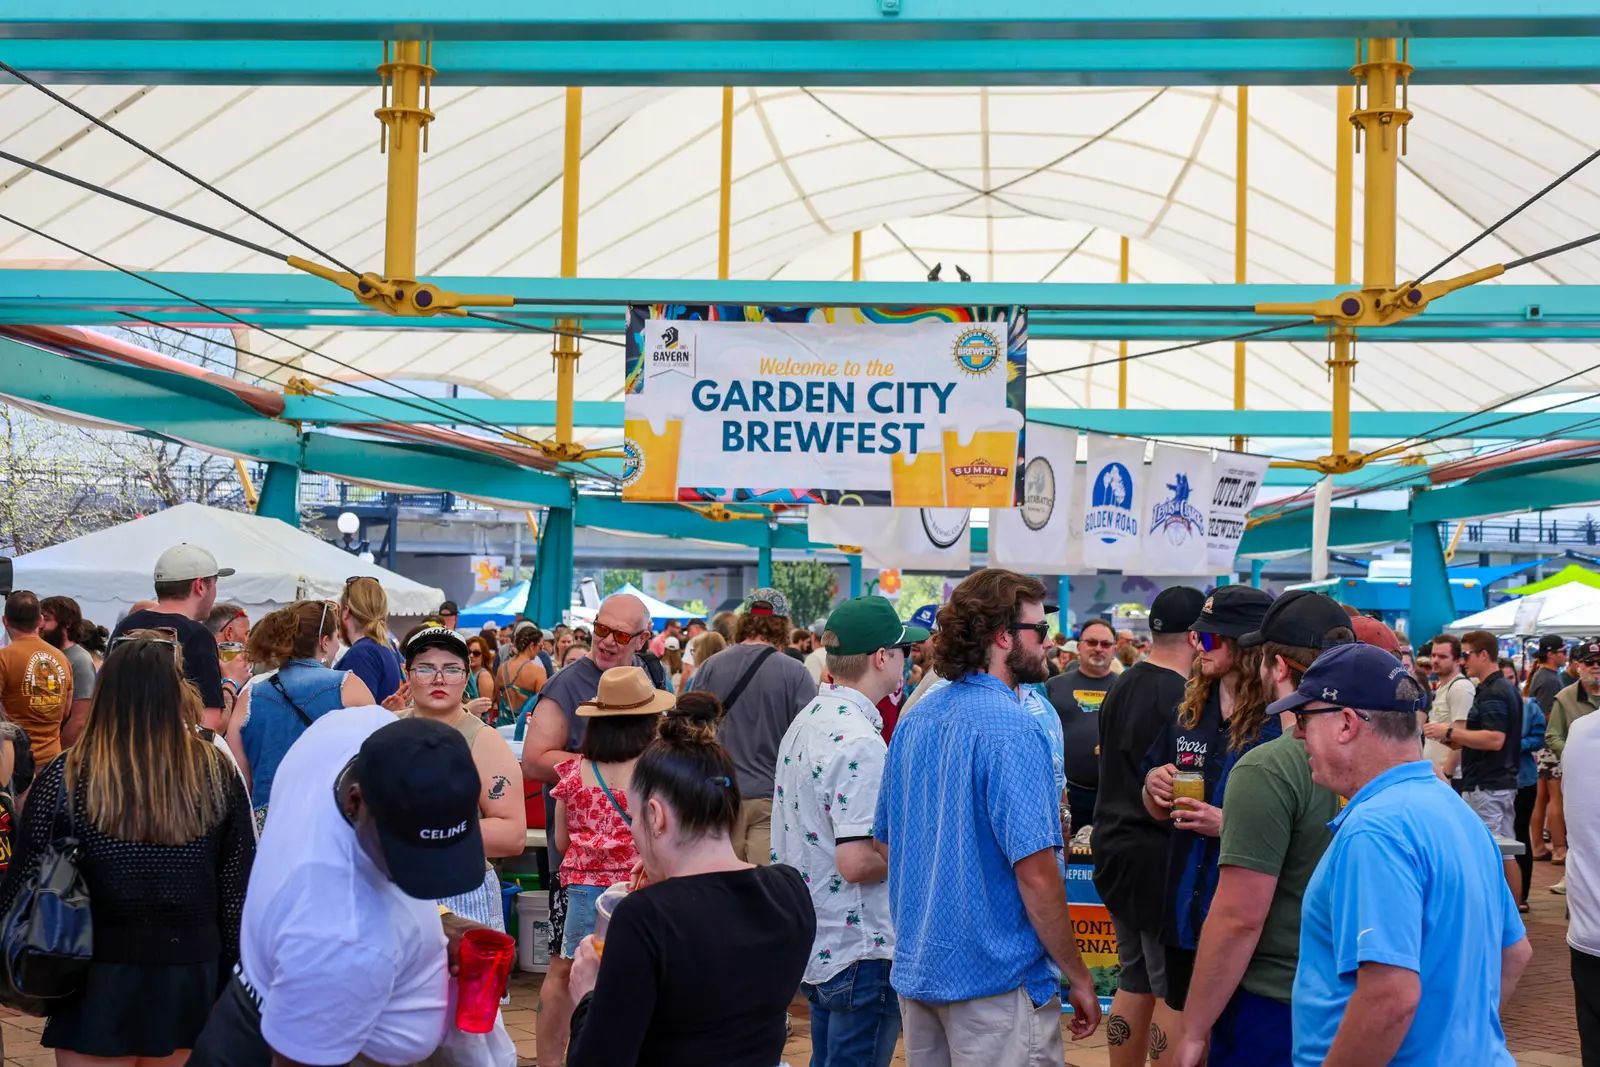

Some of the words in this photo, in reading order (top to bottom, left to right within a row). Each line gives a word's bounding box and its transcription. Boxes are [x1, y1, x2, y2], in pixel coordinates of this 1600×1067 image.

[653, 351, 689, 362] BAYERN
[958, 347, 997, 356] BREWFEST
[760, 357, 839, 377] Welcome
[843, 360, 862, 376] to
[866, 358, 895, 377] the
[691, 379, 855, 414] GARDEN
[867, 381, 957, 414] CITY
[722, 420, 925, 455] BREWFEST
[955, 467, 1006, 476] SUMMIT
[1025, 495, 1053, 508] ATABATIC
[1213, 477, 1257, 508] OUTLAW
[1085, 510, 1113, 532] GOLDEN
[1115, 512, 1137, 536] ROAD
[1177, 735, 1207, 754] Coors
[420, 820, 467, 839] CELINE
